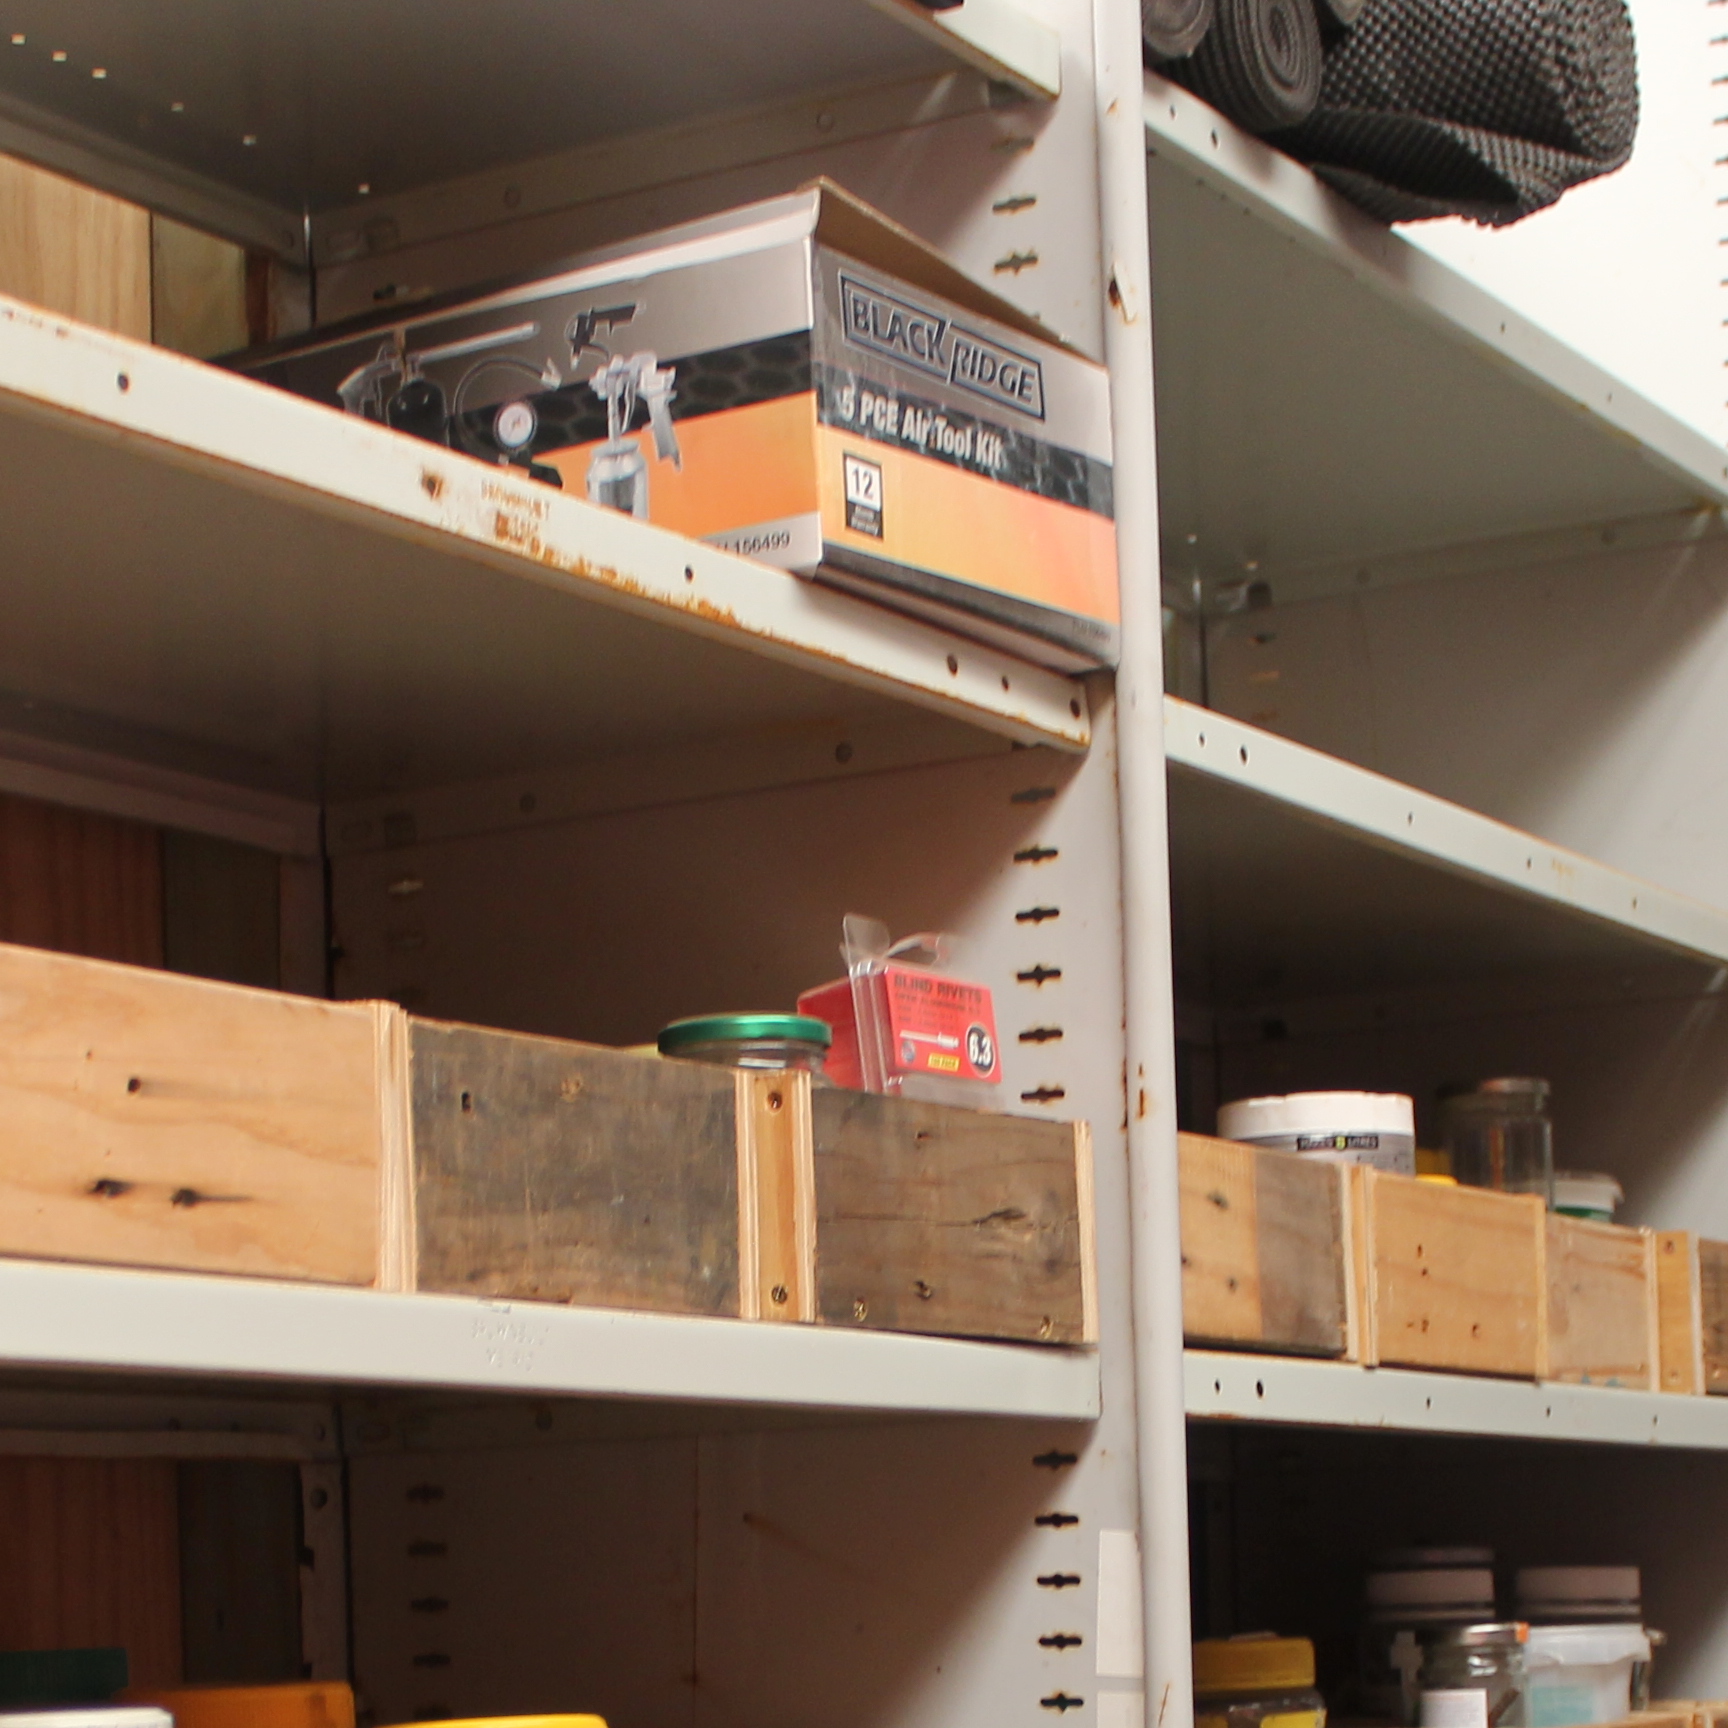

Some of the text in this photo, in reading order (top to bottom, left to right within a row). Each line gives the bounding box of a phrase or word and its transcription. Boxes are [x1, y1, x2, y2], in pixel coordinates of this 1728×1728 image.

[851, 290, 1037, 403] BLACK RIDGE
[840, 385, 1005, 471] 5 PCE Air Tool Kit
[851, 466, 874, 499] 12
[937, 981, 983, 1004] RIVETS
[968, 1031, 992, 1067] 6.3
